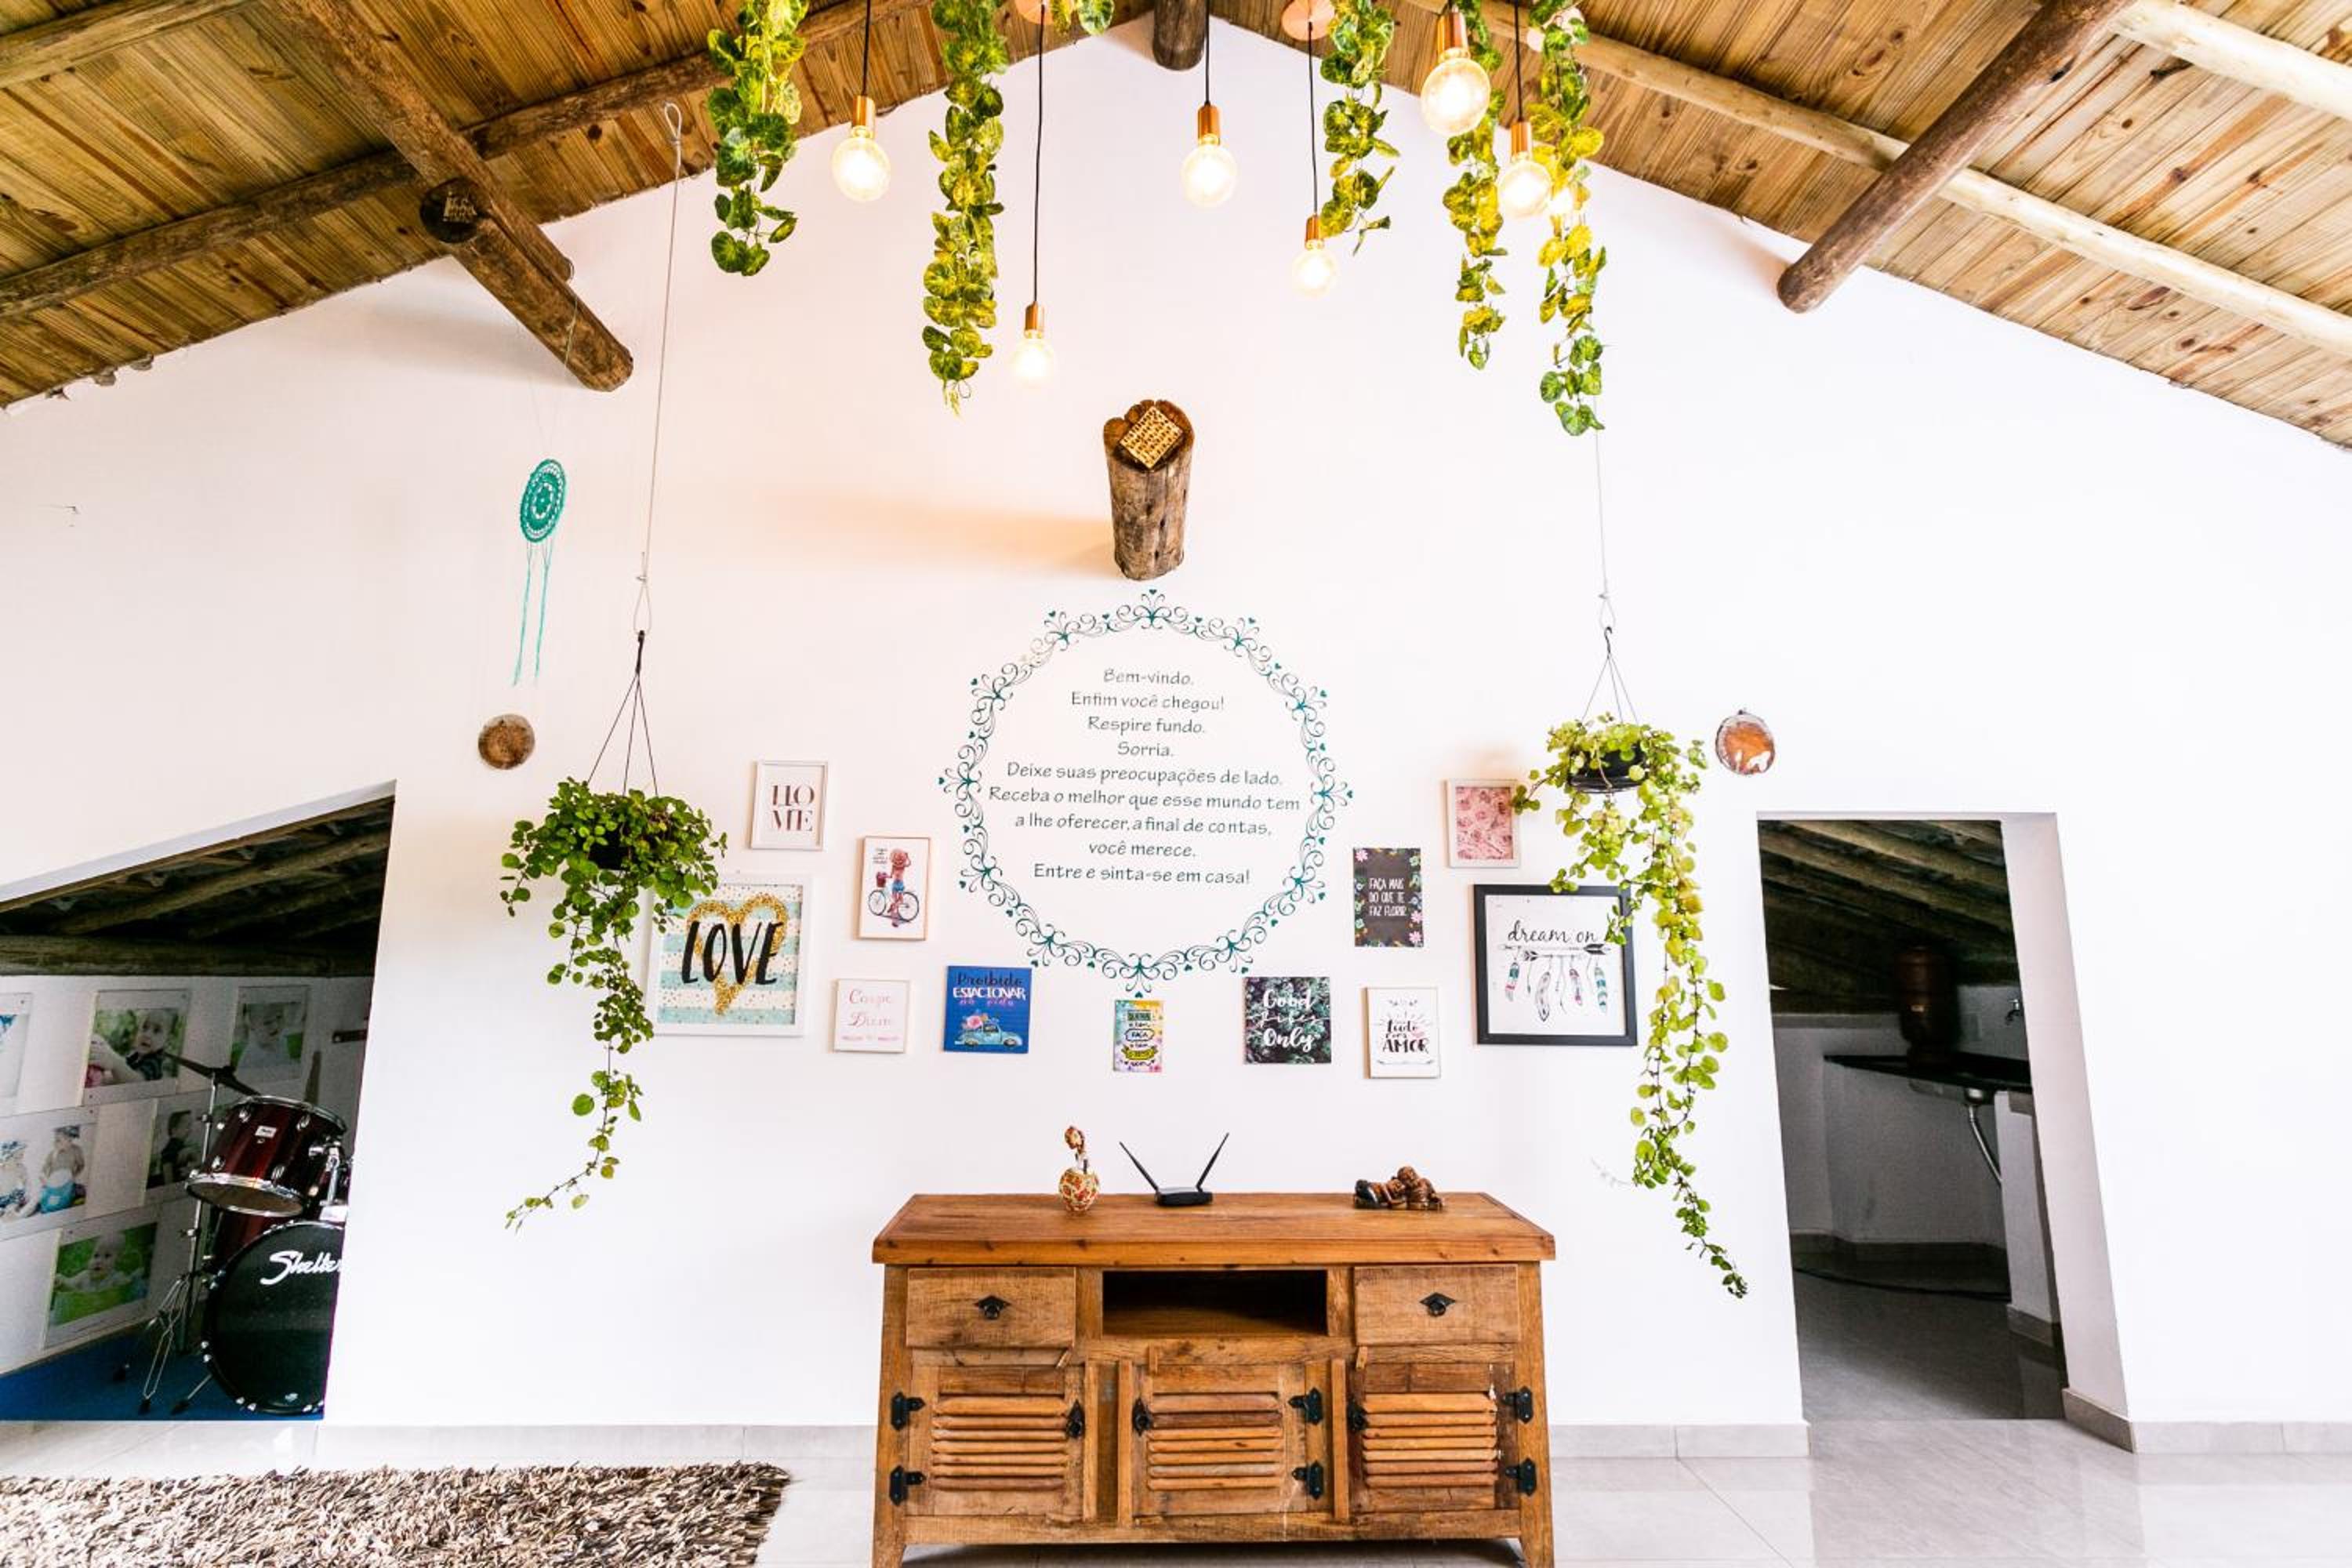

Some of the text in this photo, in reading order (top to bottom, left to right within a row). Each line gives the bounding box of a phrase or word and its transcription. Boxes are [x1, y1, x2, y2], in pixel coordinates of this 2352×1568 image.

[1103, 668, 1194, 686] Bem-vindo.
[1071, 691, 1224, 713] Enfim você chegou!
[1087, 715, 1206, 735] Respire fundo.
[1117, 741, 1175, 757] Sorria.
[1007, 761, 1283, 786] Deixe suas preocupações de lado.
[771, 784, 815, 807] HO
[989, 786, 1301, 811] Receba o melhor que esse mundo tem
[1015, 815, 1025, 827] a
[1029, 811, 1053, 828] lhe
[1183, 818, 1203, 832] de
[1088, 840, 1196, 858] você merece.
[1033, 863, 1250, 884] Entre e sinta-se em casa!
[1508, 920, 1599, 943] dream on
[681, 920, 784, 985] LOVE
[956, 971, 1023, 986] Proibido
[953, 986, 1026, 1000] ESTACIONAR
[1263, 989, 1317, 1010] Good
[1263, 1026, 1316, 1053] Only
[1382, 1038, 1430, 1054] AMOR
